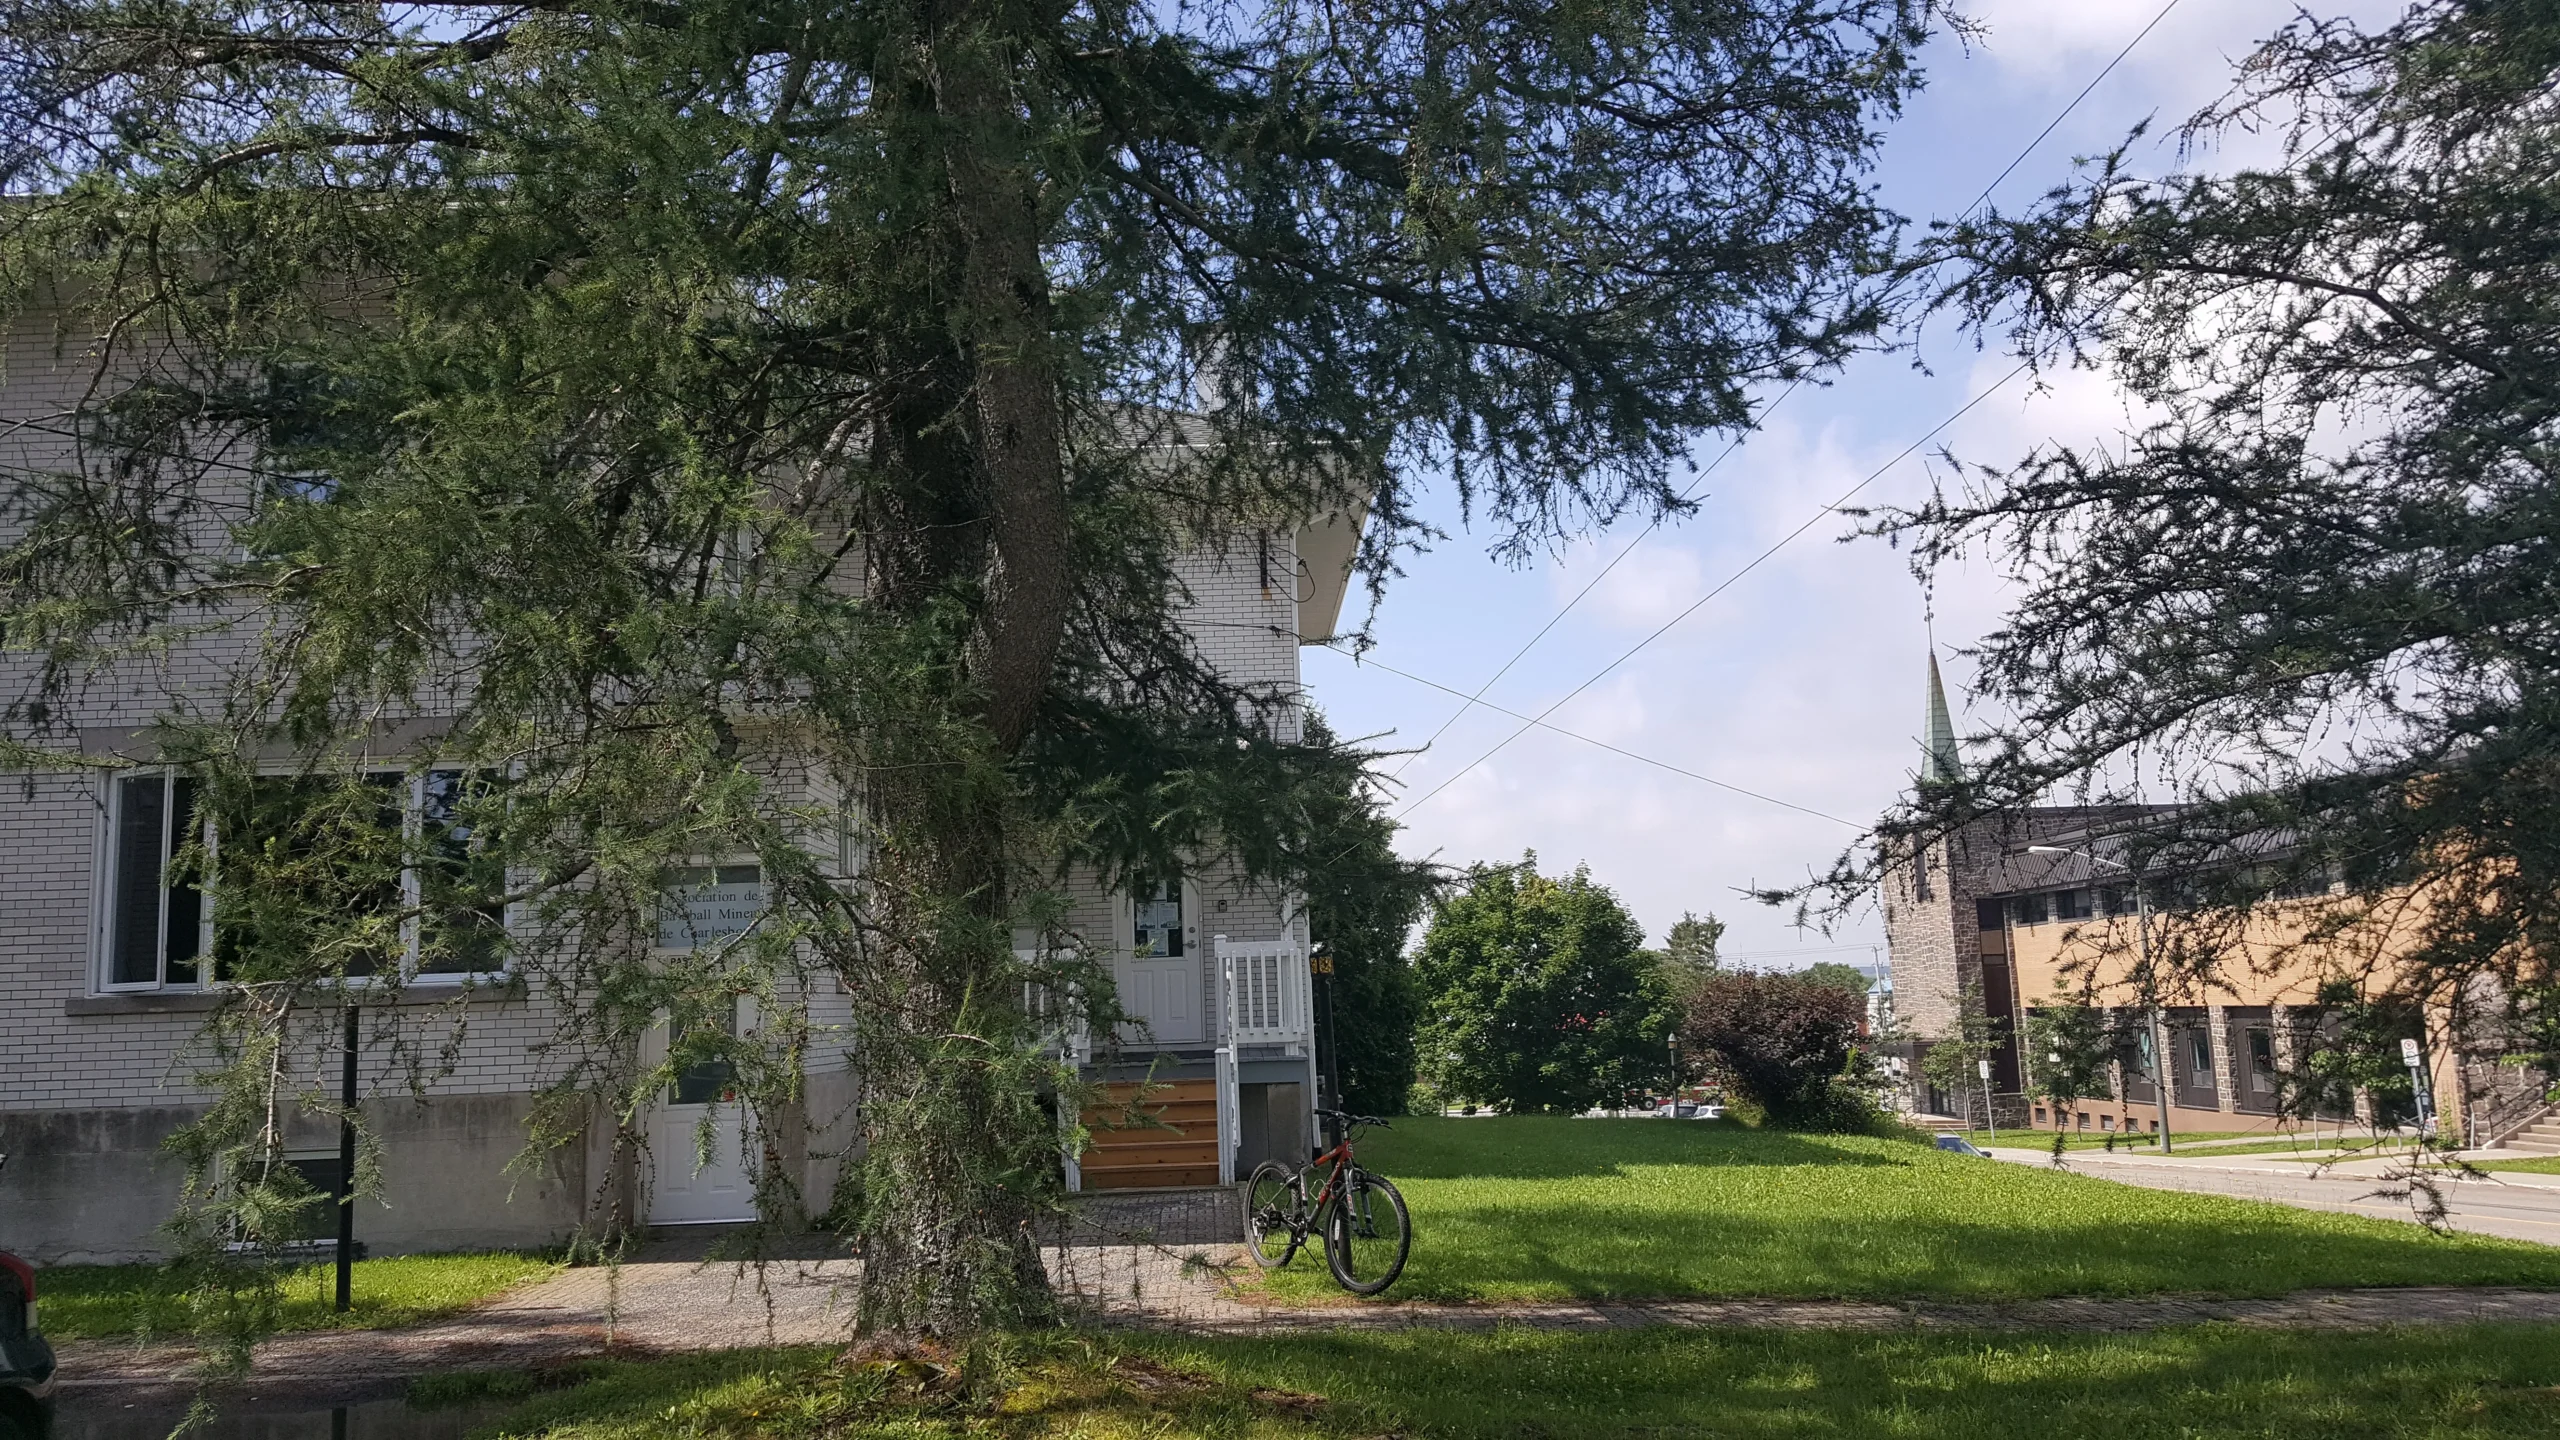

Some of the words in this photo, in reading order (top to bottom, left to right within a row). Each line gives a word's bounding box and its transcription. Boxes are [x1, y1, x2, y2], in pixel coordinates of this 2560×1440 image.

[667, 890, 737, 903] ociation
[744, 890, 758, 901] de
[660, 908, 711, 921] Baball
[719, 907, 760, 920] Mine
[660, 928, 673, 939] de
[681, 925, 761, 939] Carlesbo
